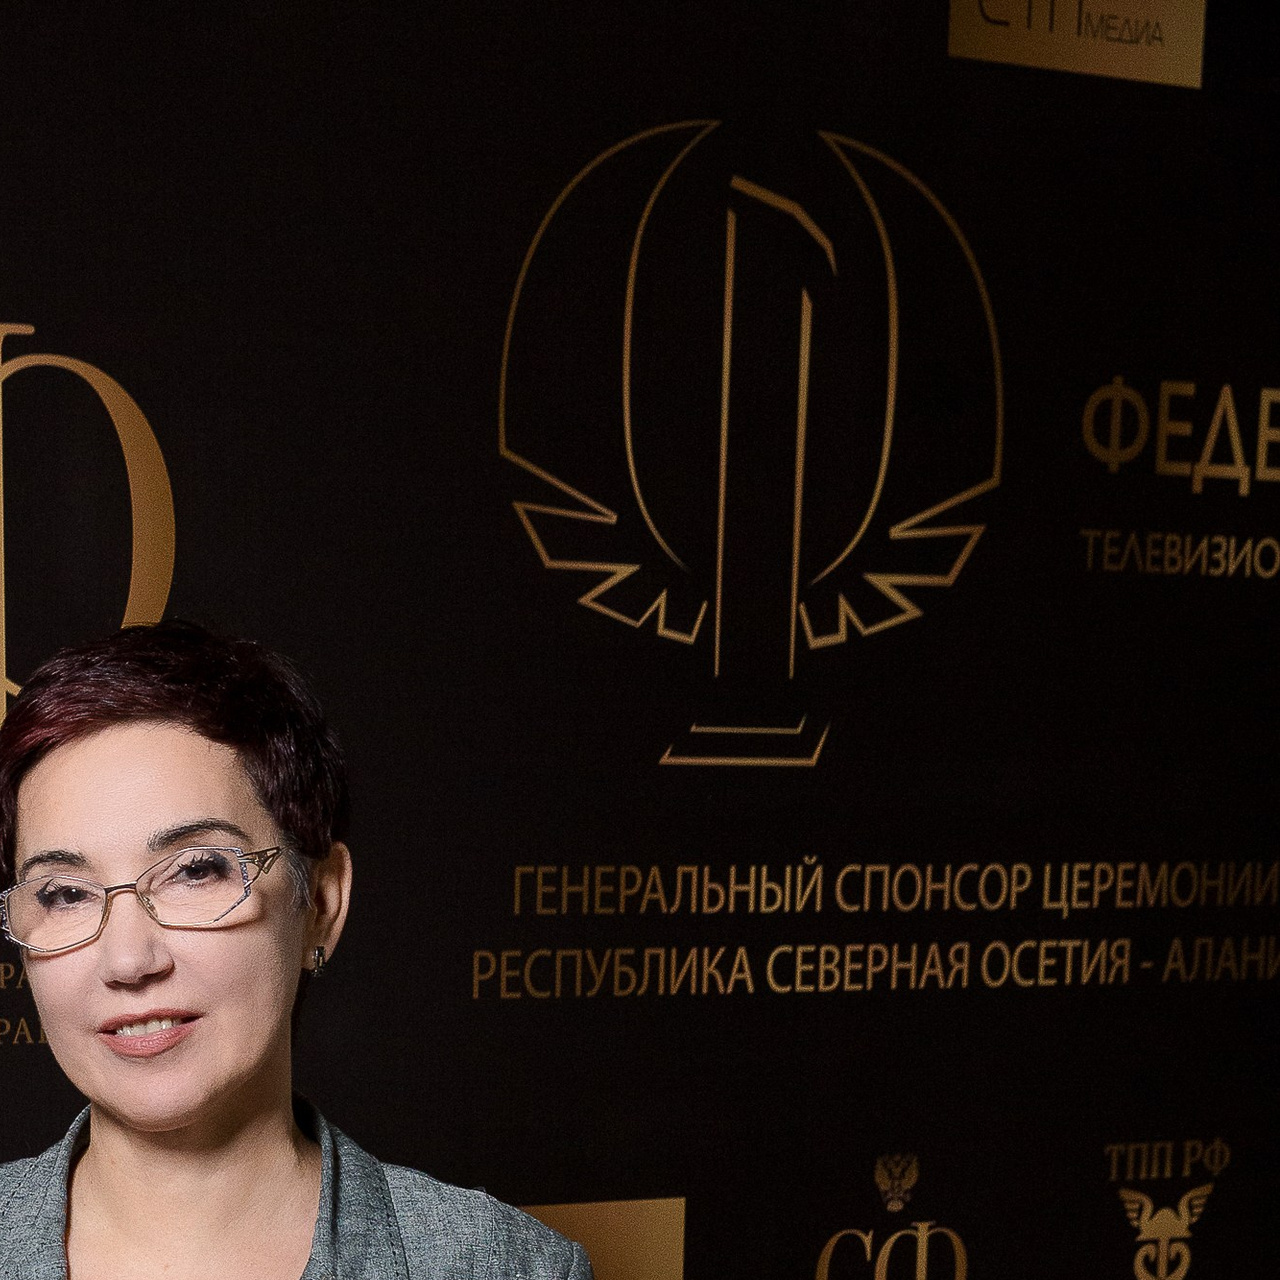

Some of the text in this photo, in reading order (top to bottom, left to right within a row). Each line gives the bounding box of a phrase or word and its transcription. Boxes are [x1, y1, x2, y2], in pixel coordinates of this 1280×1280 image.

[1084, 13, 1164, 47] МЕДИА
[1081, 375, 1280, 497] ФЕДЕ
[1079, 528, 1280, 579] ТЕЛЕВИЗИО
[513, 855, 1280, 919] ГЕНЕРАЛЬНЫЙ СПОНСОР ЦЕРЕМОНИИ
[472, 946, 755, 1000] РЕСПУБЛИКА
[765, 941, 970, 995] СЕВЕРНАЯ
[980, 938, 1131, 989] ОСЕТИЯ
[1105, 1139, 1231, 1183] ТПП РФ
